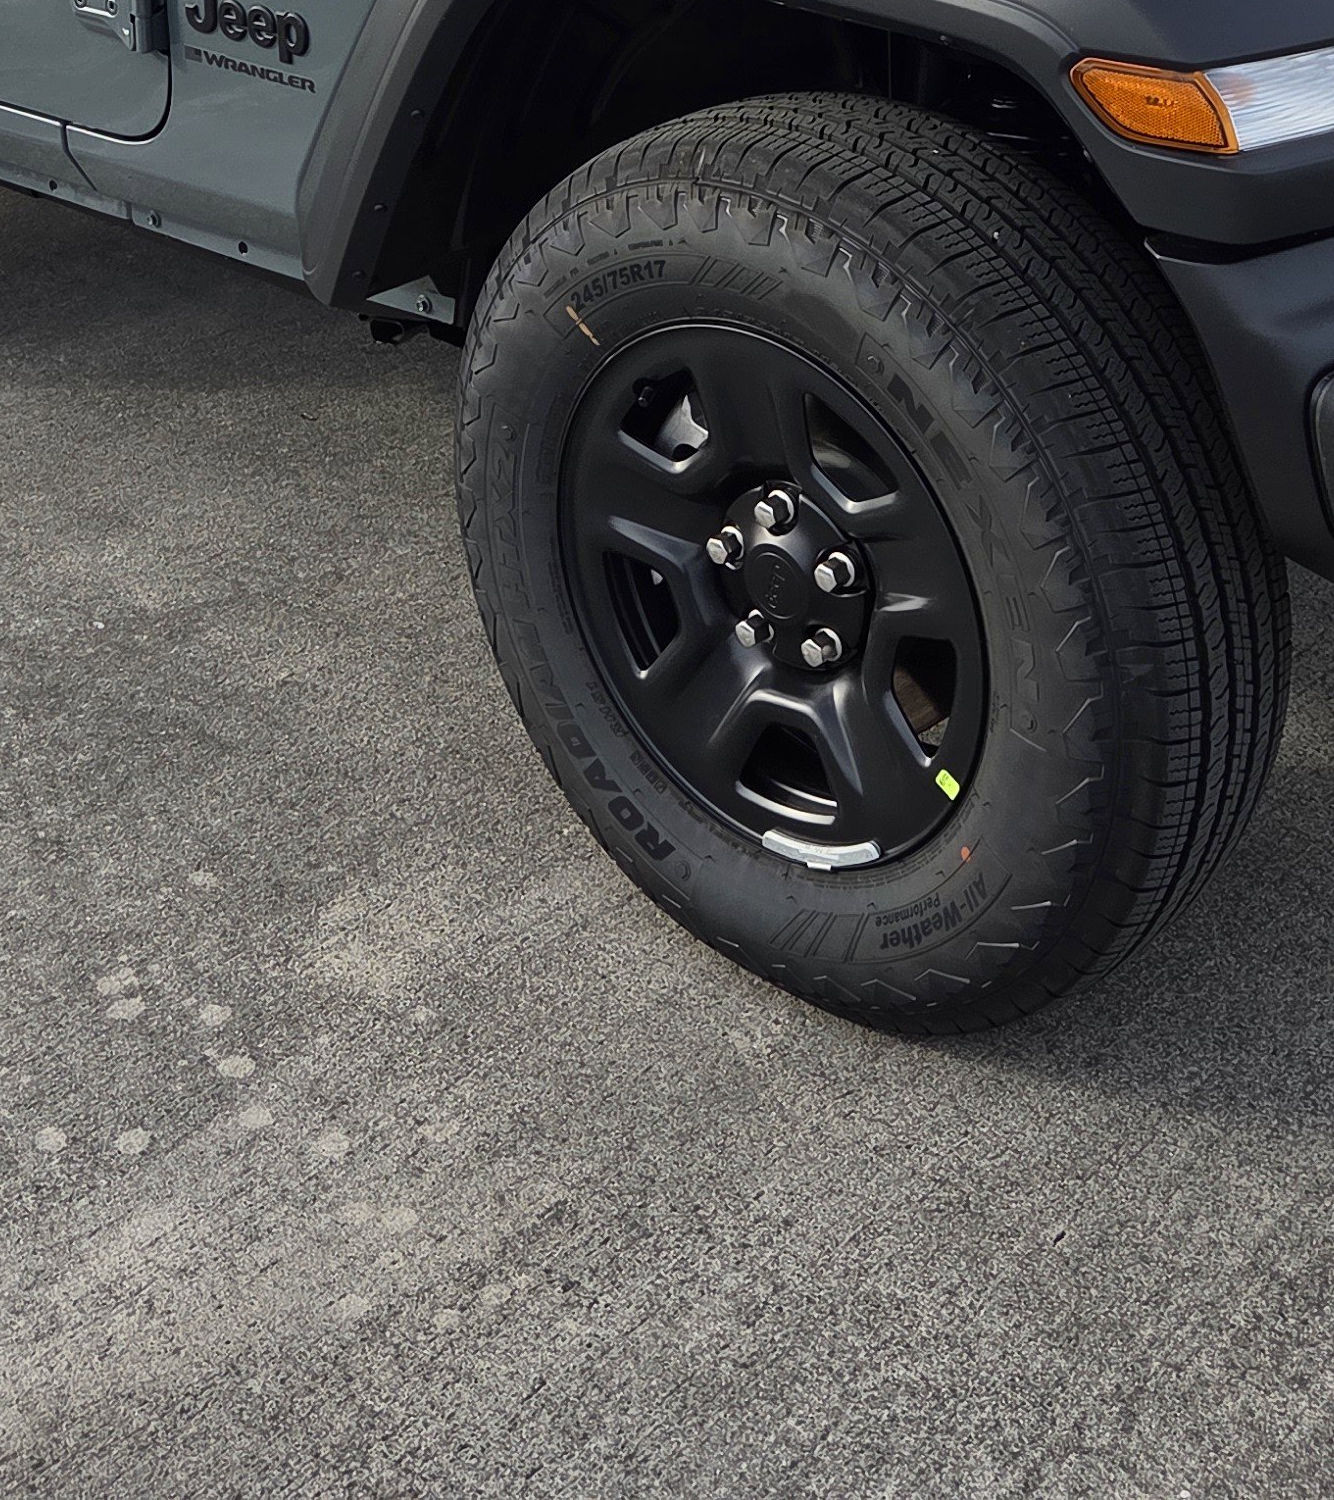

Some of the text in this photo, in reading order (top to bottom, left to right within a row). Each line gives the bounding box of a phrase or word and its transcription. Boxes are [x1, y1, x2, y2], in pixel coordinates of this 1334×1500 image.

[203, 50, 316, 93] WRANGLER
[570, 260, 666, 311] 245/75R17
[886, 372, 1041, 704] NEXEN
[874, 891, 941, 928] Performance
[878, 871, 989, 951] All-Weather
